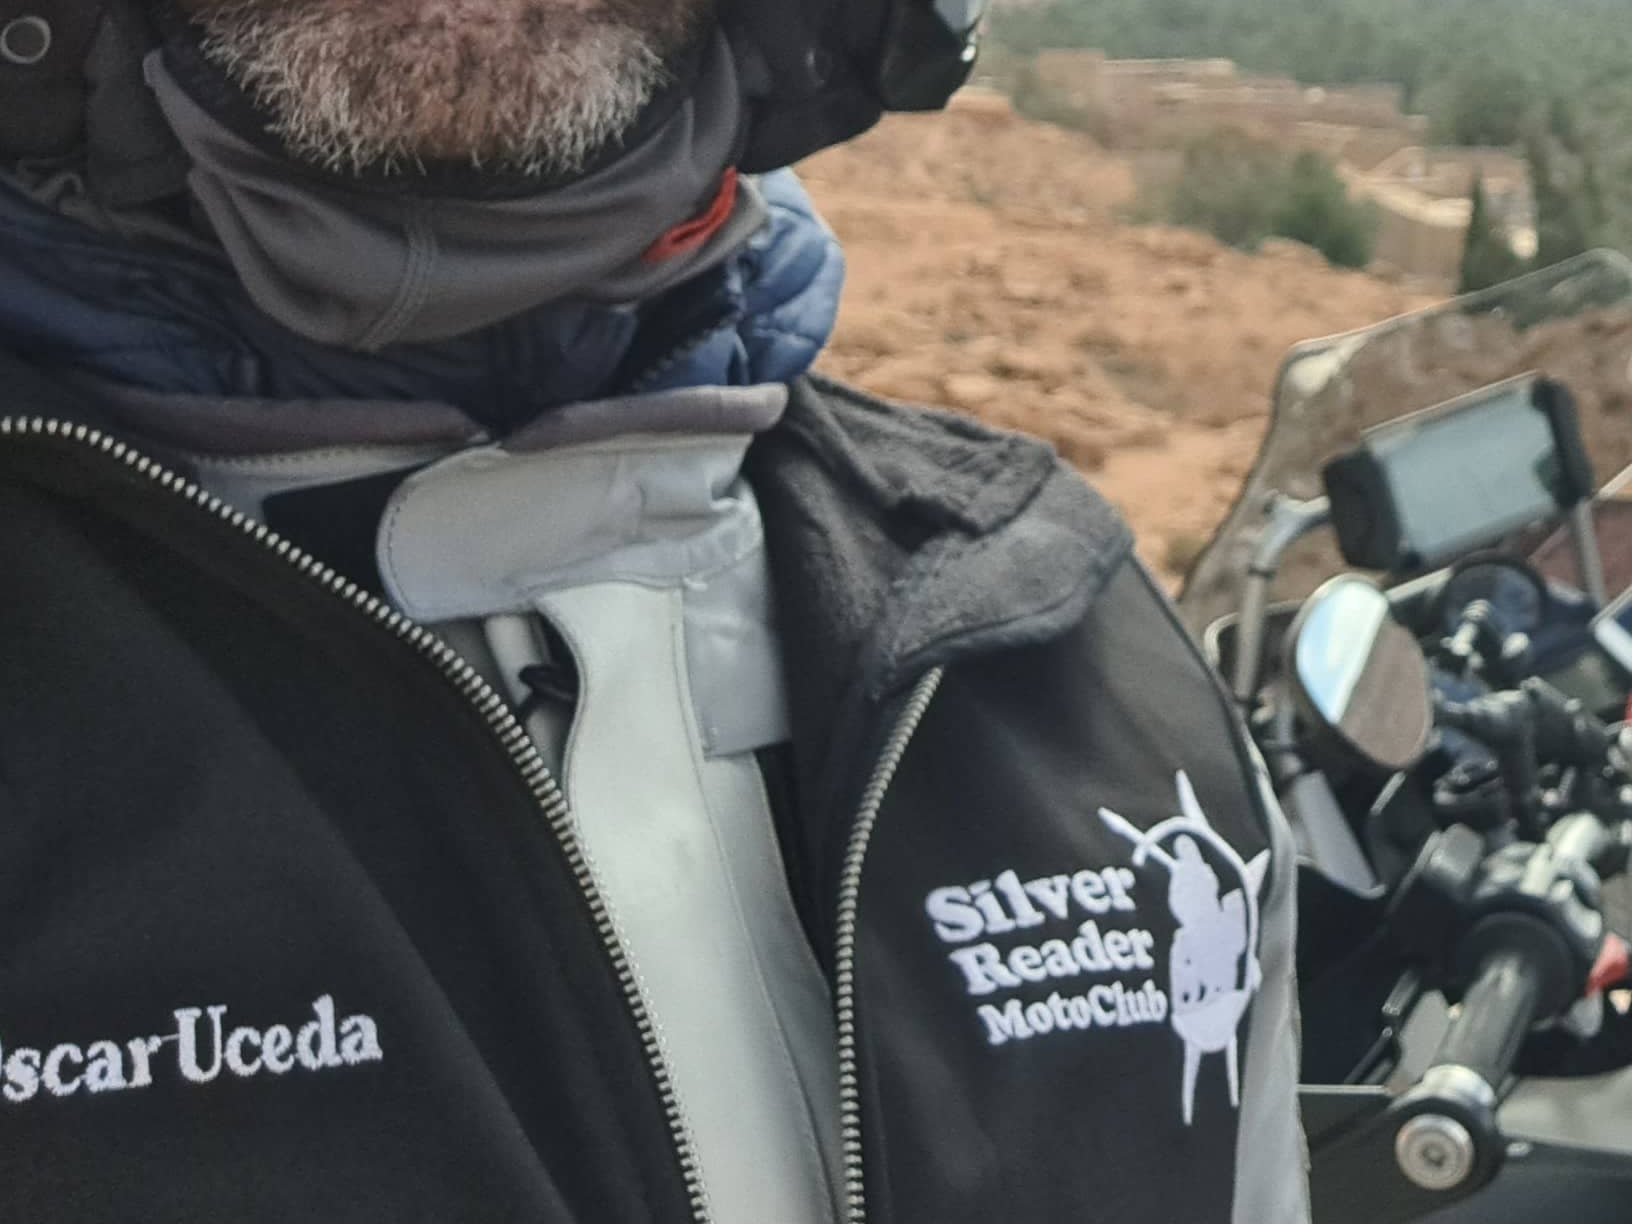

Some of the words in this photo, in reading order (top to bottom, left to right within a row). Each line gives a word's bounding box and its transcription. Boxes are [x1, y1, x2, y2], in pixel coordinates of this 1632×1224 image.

[925, 866, 1136, 942] Silver
[948, 919, 1154, 995] Reader
[0, 1034, 163, 1102] scar
[173, 993, 383, 1082] Uceda
[976, 979, 1168, 1046] MotoClub
